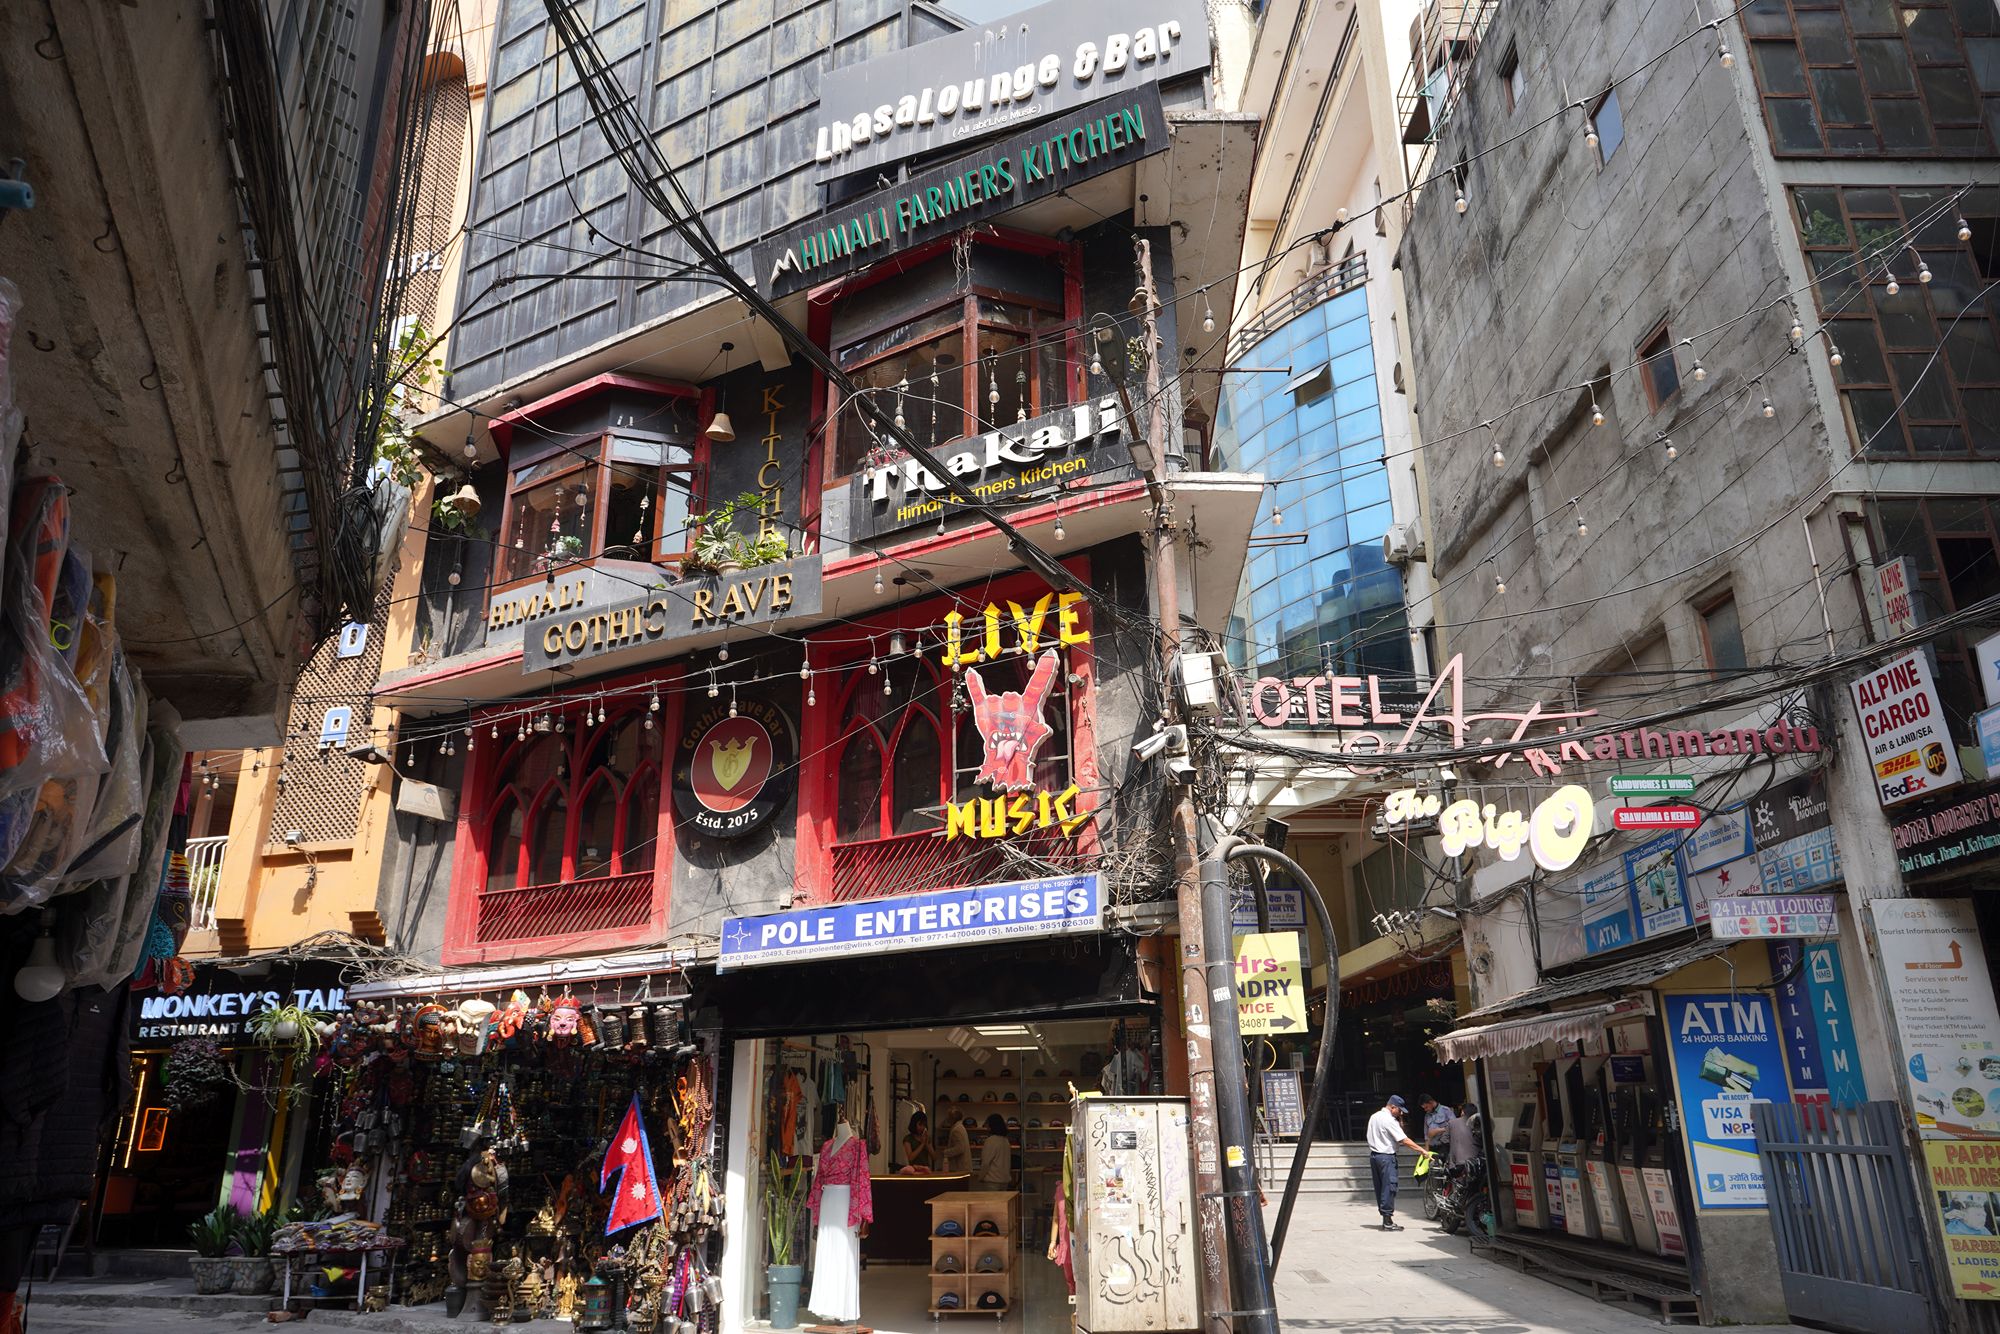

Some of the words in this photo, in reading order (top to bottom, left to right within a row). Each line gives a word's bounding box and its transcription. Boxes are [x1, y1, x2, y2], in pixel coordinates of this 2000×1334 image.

[1073, 41, 1099, 80] &
[1103, 17, 1182, 74] Bar
[799, 207, 891, 271] HIMALI
[895, 157, 1016, 233] FARMERS
[1022, 103, 1147, 185] KITCHEN
[863, 397, 1121, 502] Thakali
[1020, 456, 1087, 484] Kitchen
[1880, 562, 1905, 597] ALPINE
[488, 580, 586, 631] HIMALI
[543, 597, 668, 655] GOTHIC
[692, 572, 794, 626] RAVE
[1886, 592, 1911, 626] CARGO
[941, 591, 1091, 667] LIVE
[1857, 658, 1921, 711] ALPINE
[1251, 674, 1402, 728] OTEL
[682, 703, 725, 750] Gothic
[763, 707, 785, 738] Bar
[1864, 691, 1932, 739] CARGO
[1874, 742, 1889, 756] AIR
[1889, 740, 1898, 751] &
[1897, 725, 1934, 750] LAND/SEA
[1881, 753, 1921, 776] DHL
[1925, 751, 1946, 771] ups
[1881, 774, 1928, 802] FedEx
[946, 783, 1090, 841] MUSIC
[1797, 795, 1814, 808] YAK
[695, 812, 725, 830] Estd.
[727, 808, 759, 829] 2075
[1384, 788, 1442, 825] The
[1437, 798, 1531, 862] Big
[1529, 784, 1594, 872] O
[1619, 812, 1663, 822] SHAWARMA
[1670, 810, 1696, 821] KEBAB
[1892, 816, 1934, 850] HOTEL
[1930, 797, 1990, 839] JOURNEY
[1900, 856, 1915, 873] 2nd
[1914, 851, 1936, 869] Floor
[760, 916, 836, 948] POLE
[854, 887, 1090, 937] ENTERPRISES
[1714, 903, 1731, 917] 24
[1779, 898, 1833, 915] LOUNGE
[910, 934, 925, 943] Tel:
[1005, 922, 1038, 934] Mobile:
[1040, 917, 1095, 930] 9851026308
[1599, 922, 1621, 948] ATM
[1719, 921, 1740, 936] VISA
[1878, 928, 1905, 936] Tourist
[1905, 927, 1951, 935] Information
[1951, 926, 1977, 934] Center
[1815, 969, 1832, 979] NMB
[1905, 975, 1938, 983] Services
[1949, 975, 1968, 983] offer
[1236, 978, 1292, 999] NDRY
[140, 989, 281, 1020] MONKEY'S
[293, 986, 352, 1013] TAIL
[1239, 1002, 1275, 1014] VICE
[138, 1022, 240, 1039] RESTAURANT
[1681, 1001, 1767, 1035] ATM
[1823, 989, 1850, 1073] ATM
[1681, 1035, 1692, 1043] 24
[1694, 1034, 1726, 1043] HOURS
[1727, 1034, 1768, 1042] BANKING
[1796, 1026, 1813, 1081] ATM
[1709, 1107, 1744, 1119] VISA
[1944, 1144, 2000, 1165] PAPP
[1513, 1173, 1530, 1187] ATM
[1932, 1166, 1969, 1187] HAIR
[1655, 1209, 1678, 1228] ATM
[1951, 1238, 2000, 1254] BARBE
[1957, 1257, 1999, 1267] LADIES
